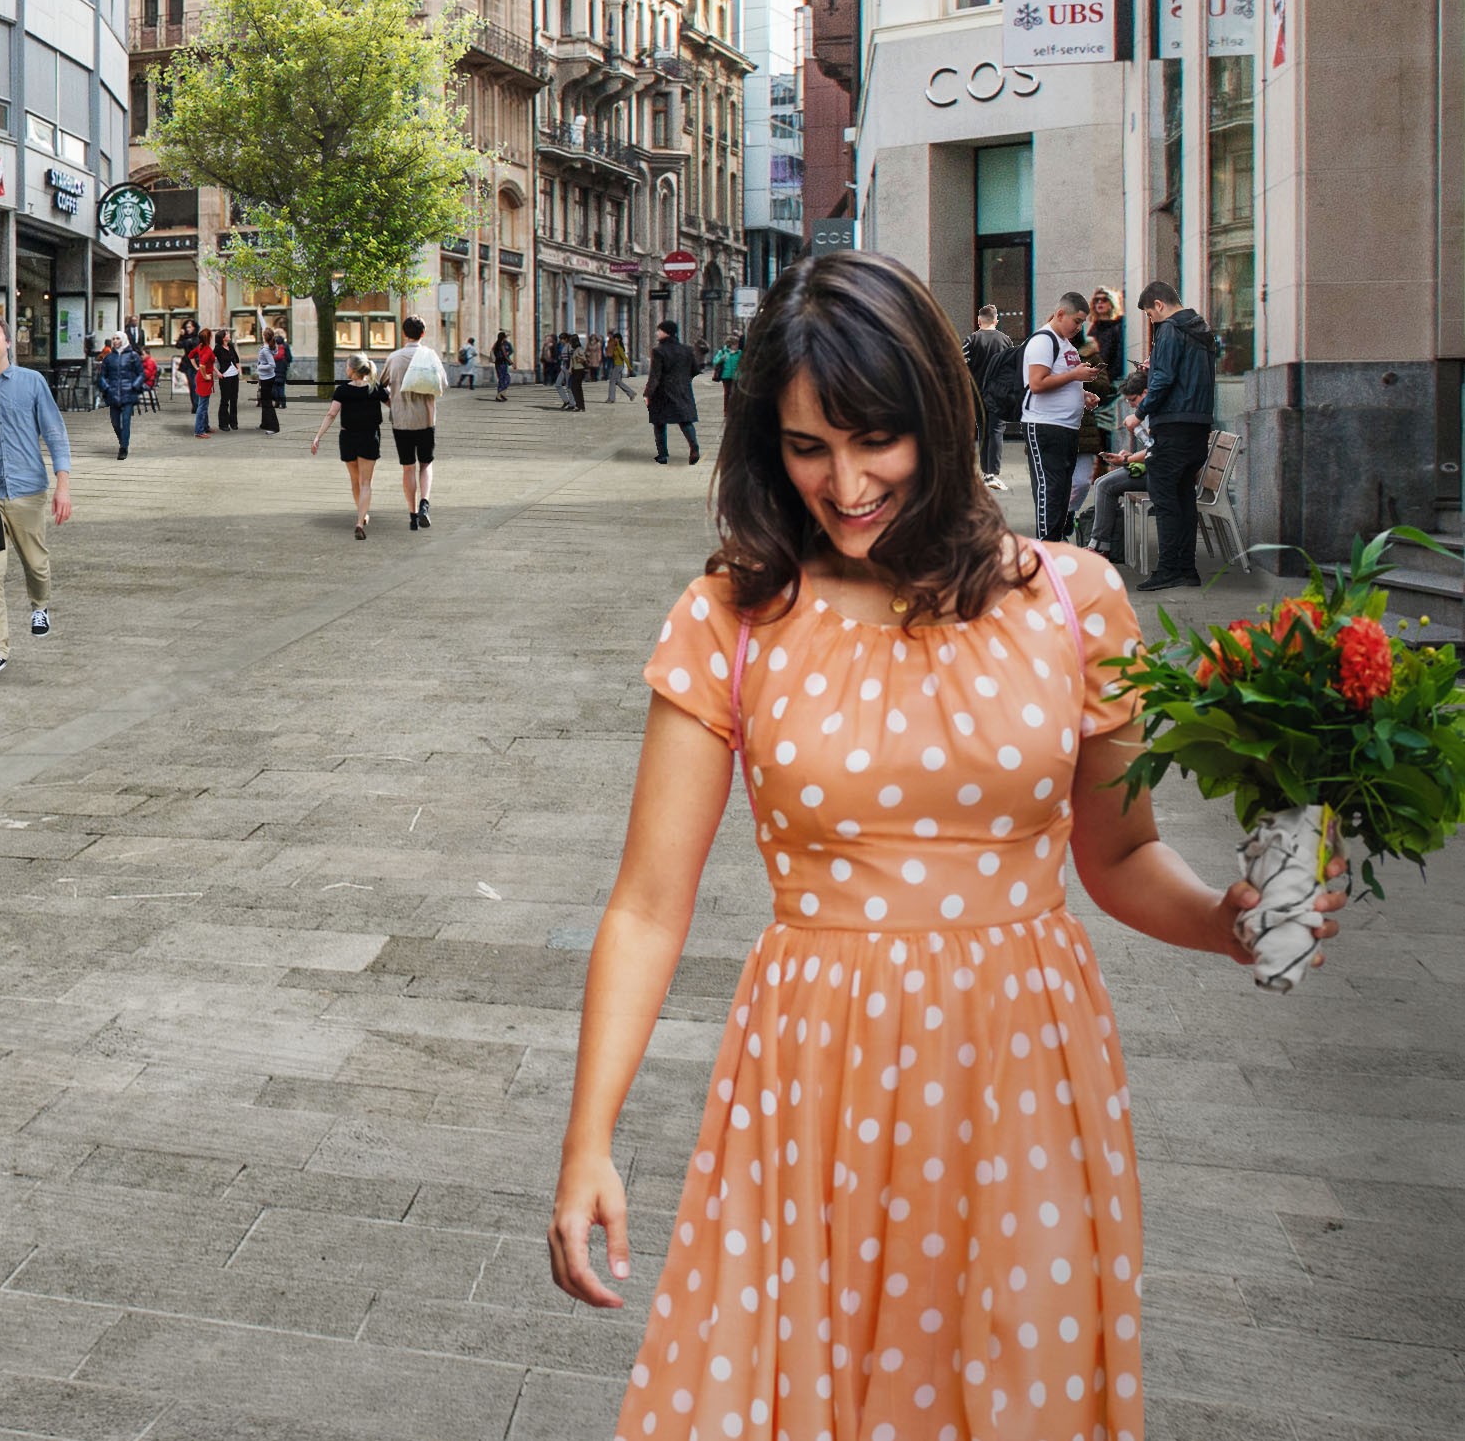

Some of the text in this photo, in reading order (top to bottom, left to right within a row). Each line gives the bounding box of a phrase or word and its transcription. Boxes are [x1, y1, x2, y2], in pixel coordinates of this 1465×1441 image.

[1047, 2, 1104, 25] UBS
[1033, 44, 1105, 57] self-service
[925, 61, 1041, 108] COS
[133, 239, 191, 249] MEZGER
[815, 231, 852, 245] COS
